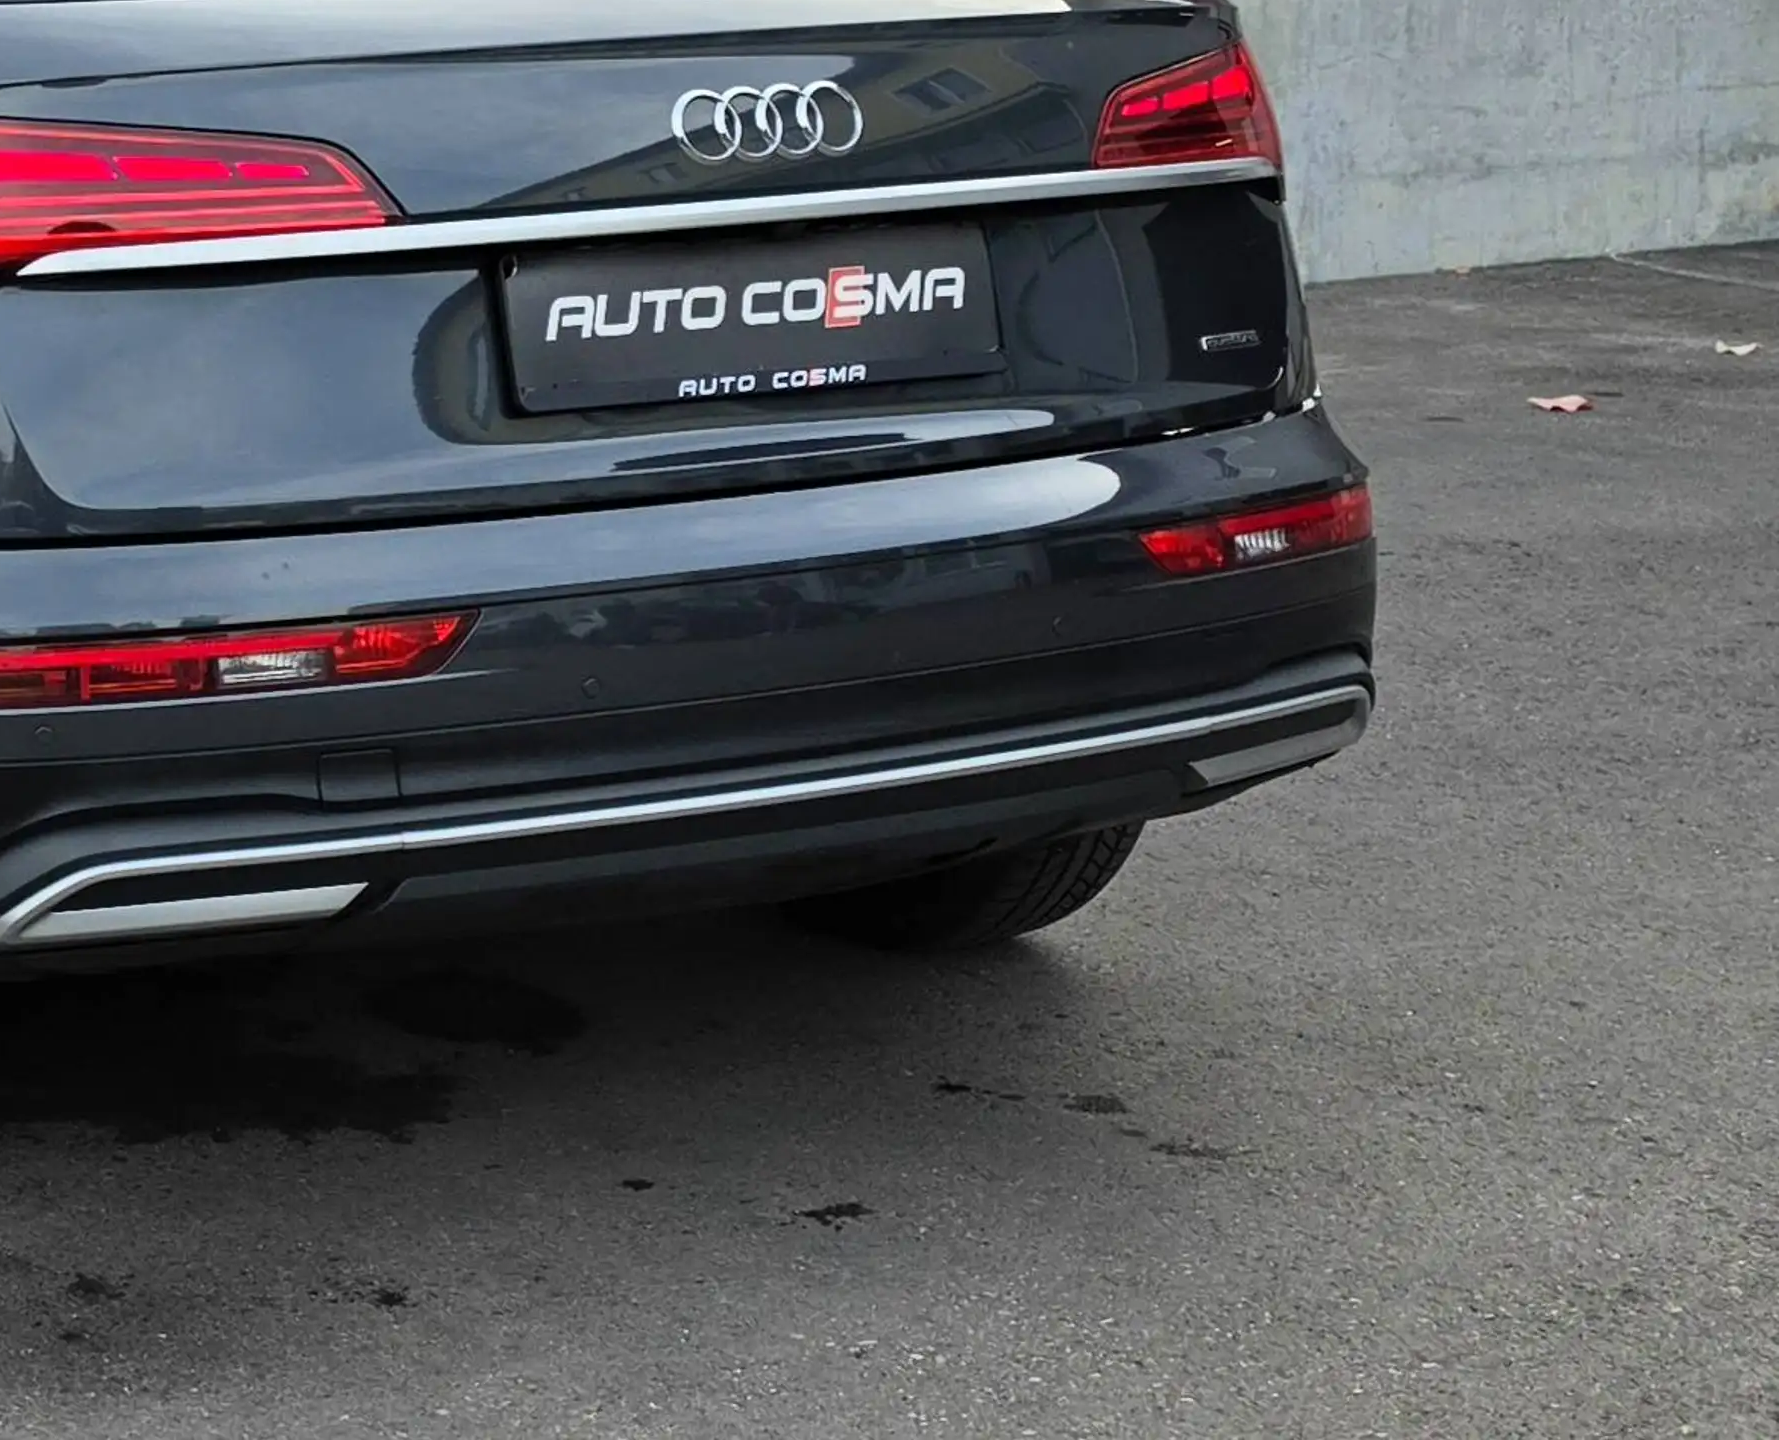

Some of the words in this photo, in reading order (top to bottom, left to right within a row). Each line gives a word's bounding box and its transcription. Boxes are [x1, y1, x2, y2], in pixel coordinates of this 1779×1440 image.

[546, 285, 726, 341] AUTO
[741, 266, 965, 326] COSMA
[679, 375, 755, 398] AUTO
[772, 365, 866, 392] COSMA
